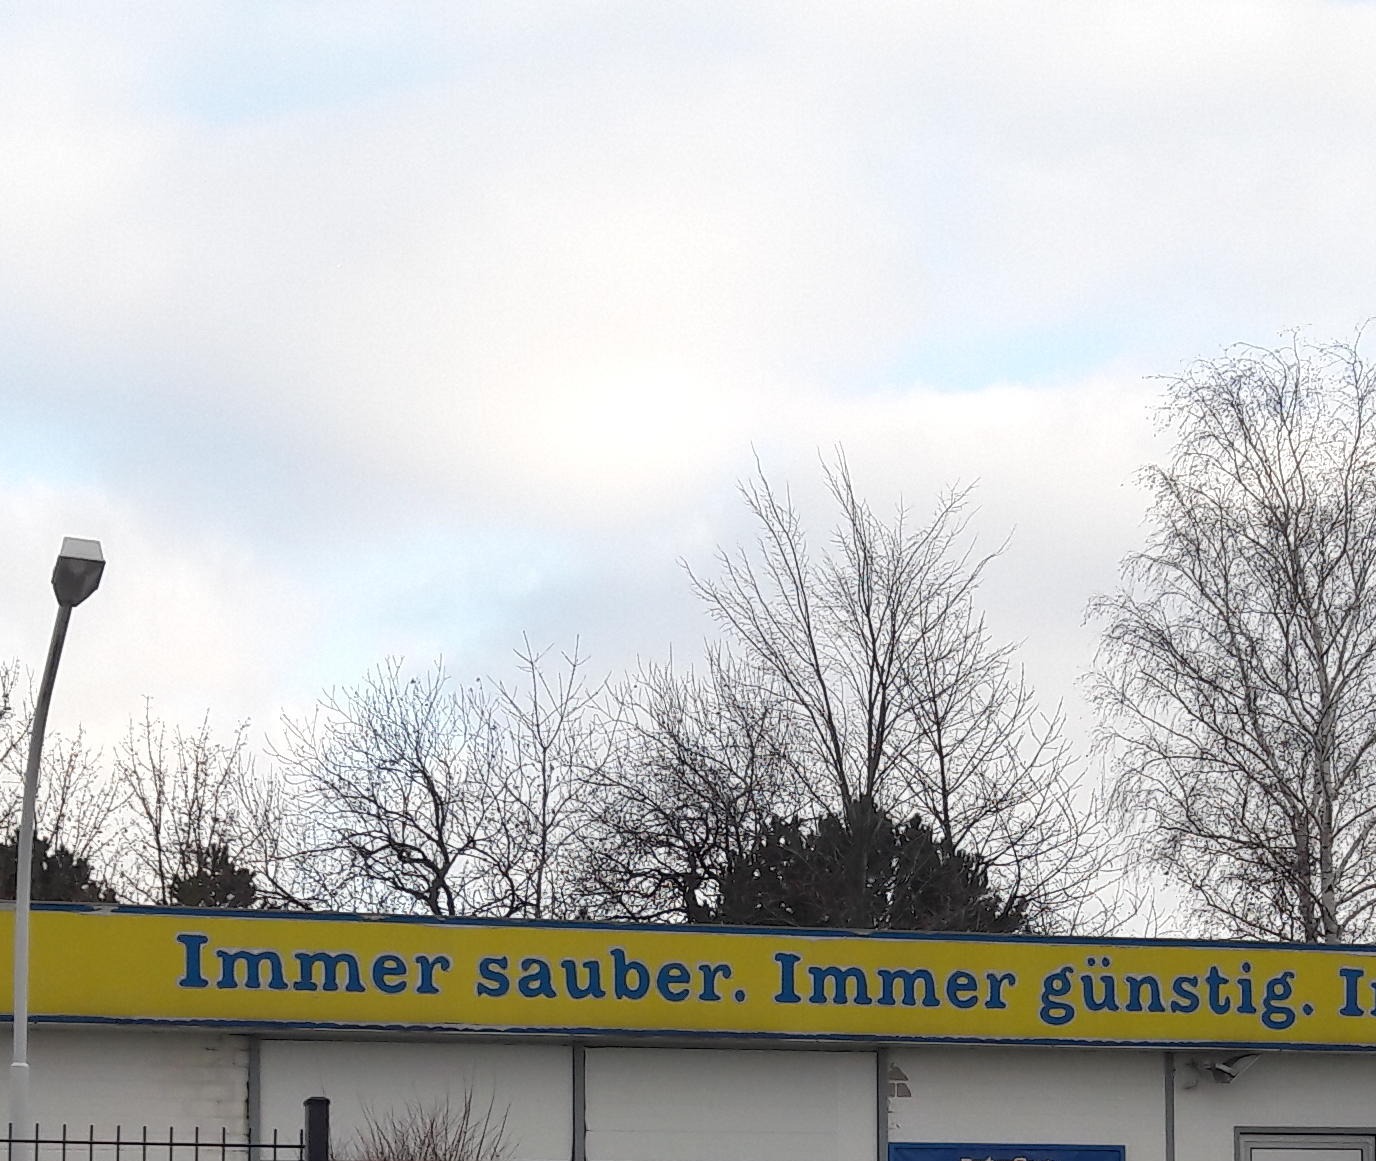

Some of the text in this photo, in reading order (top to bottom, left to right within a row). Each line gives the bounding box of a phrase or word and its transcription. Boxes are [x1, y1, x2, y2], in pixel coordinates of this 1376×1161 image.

[176, 934, 450, 995] Immer
[477, 948, 747, 1002] sauber.
[774, 952, 1015, 1009] Immer
[1040, 956, 1314, 1030] günstig.
